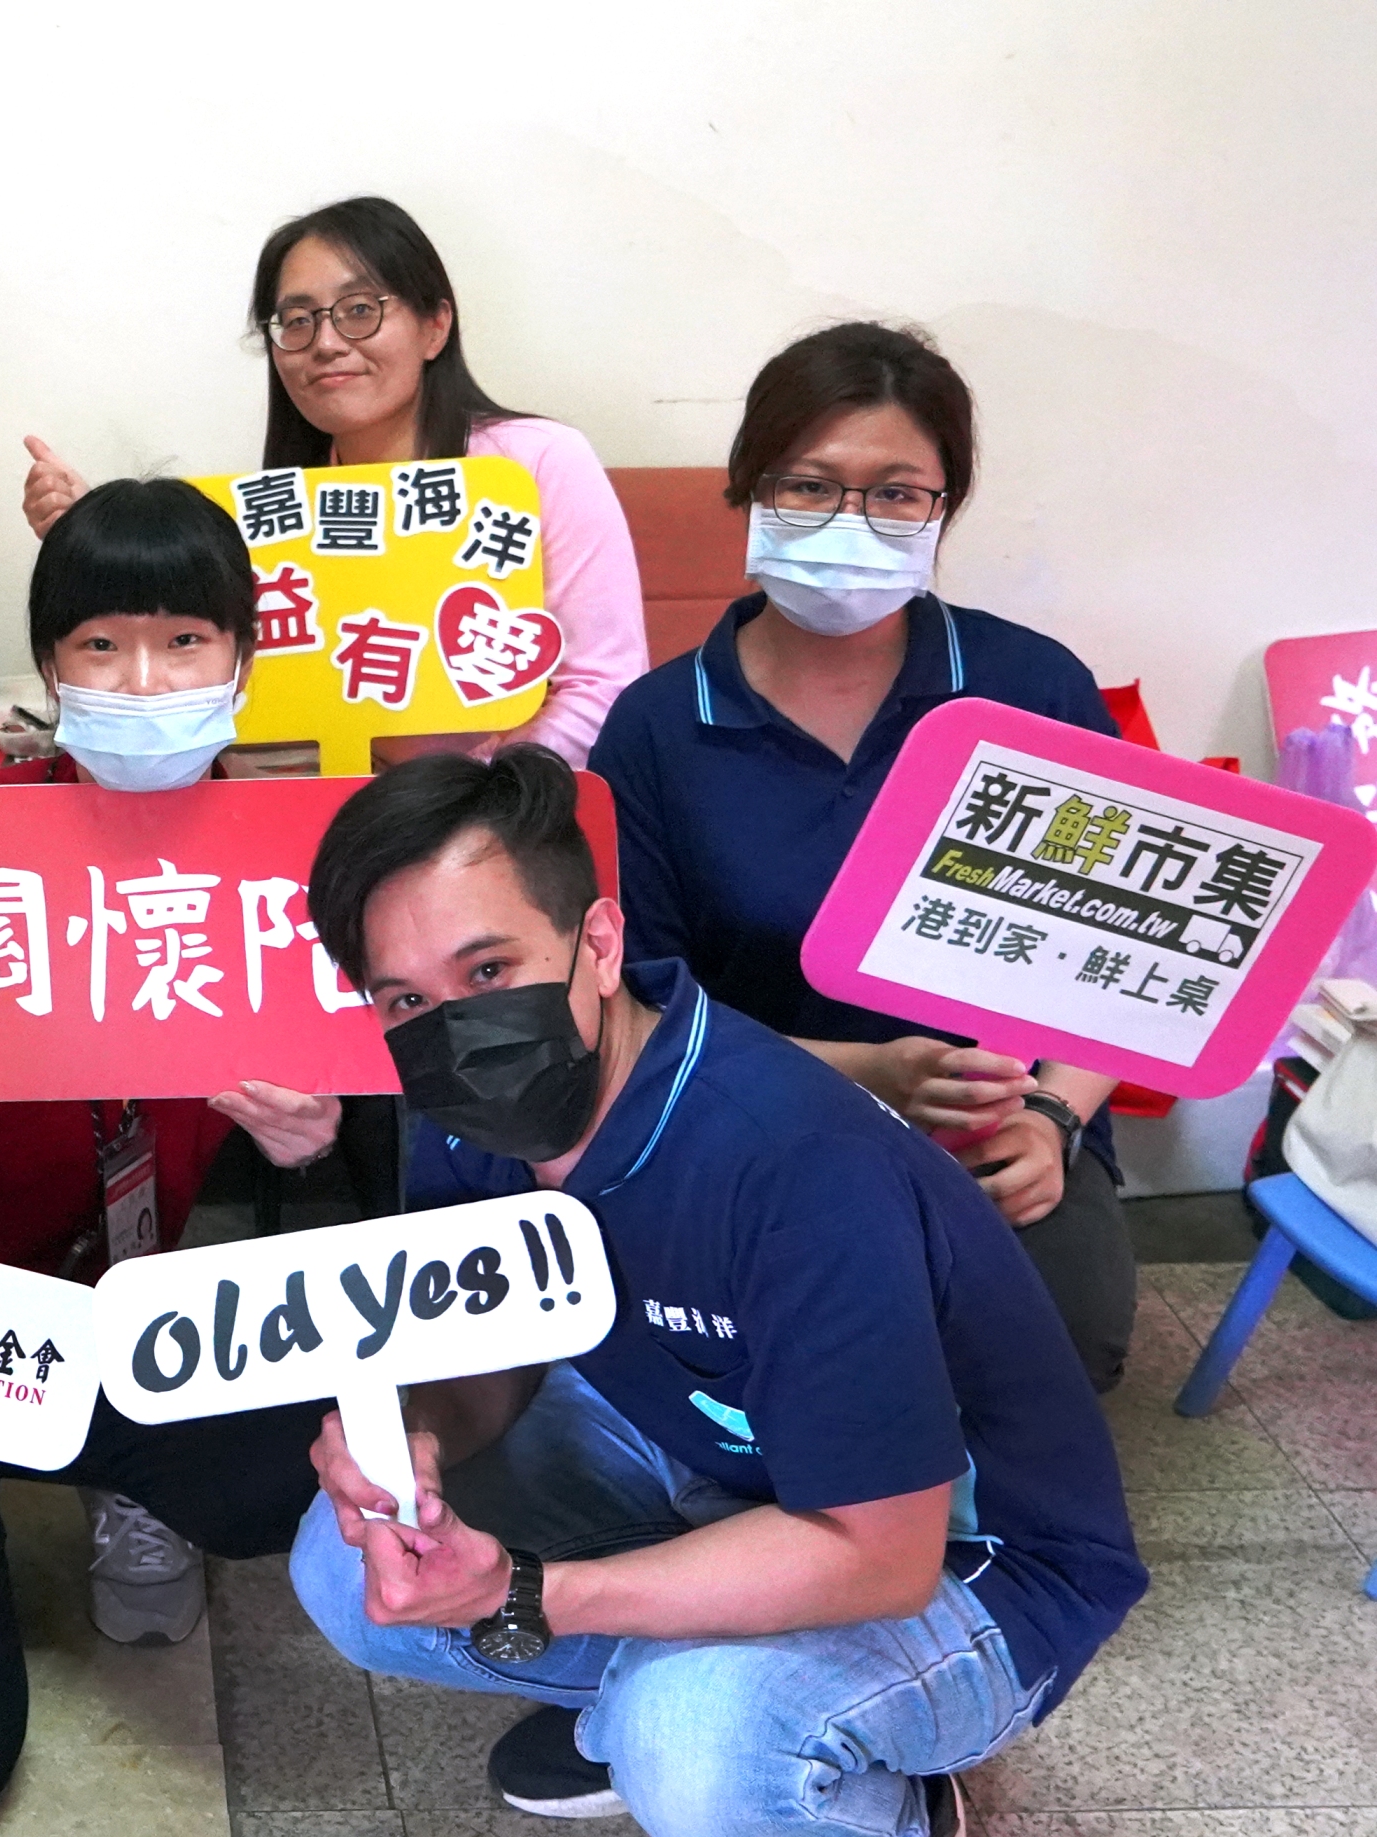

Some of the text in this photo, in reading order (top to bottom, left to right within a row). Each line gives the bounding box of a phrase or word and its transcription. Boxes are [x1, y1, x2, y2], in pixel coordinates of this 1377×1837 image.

[237, 467, 533, 573] 嘉豐海洋
[930, 849, 1177, 940] FreshMarket.com.tw
[955, 772, 1287, 923] 新鮮市集
